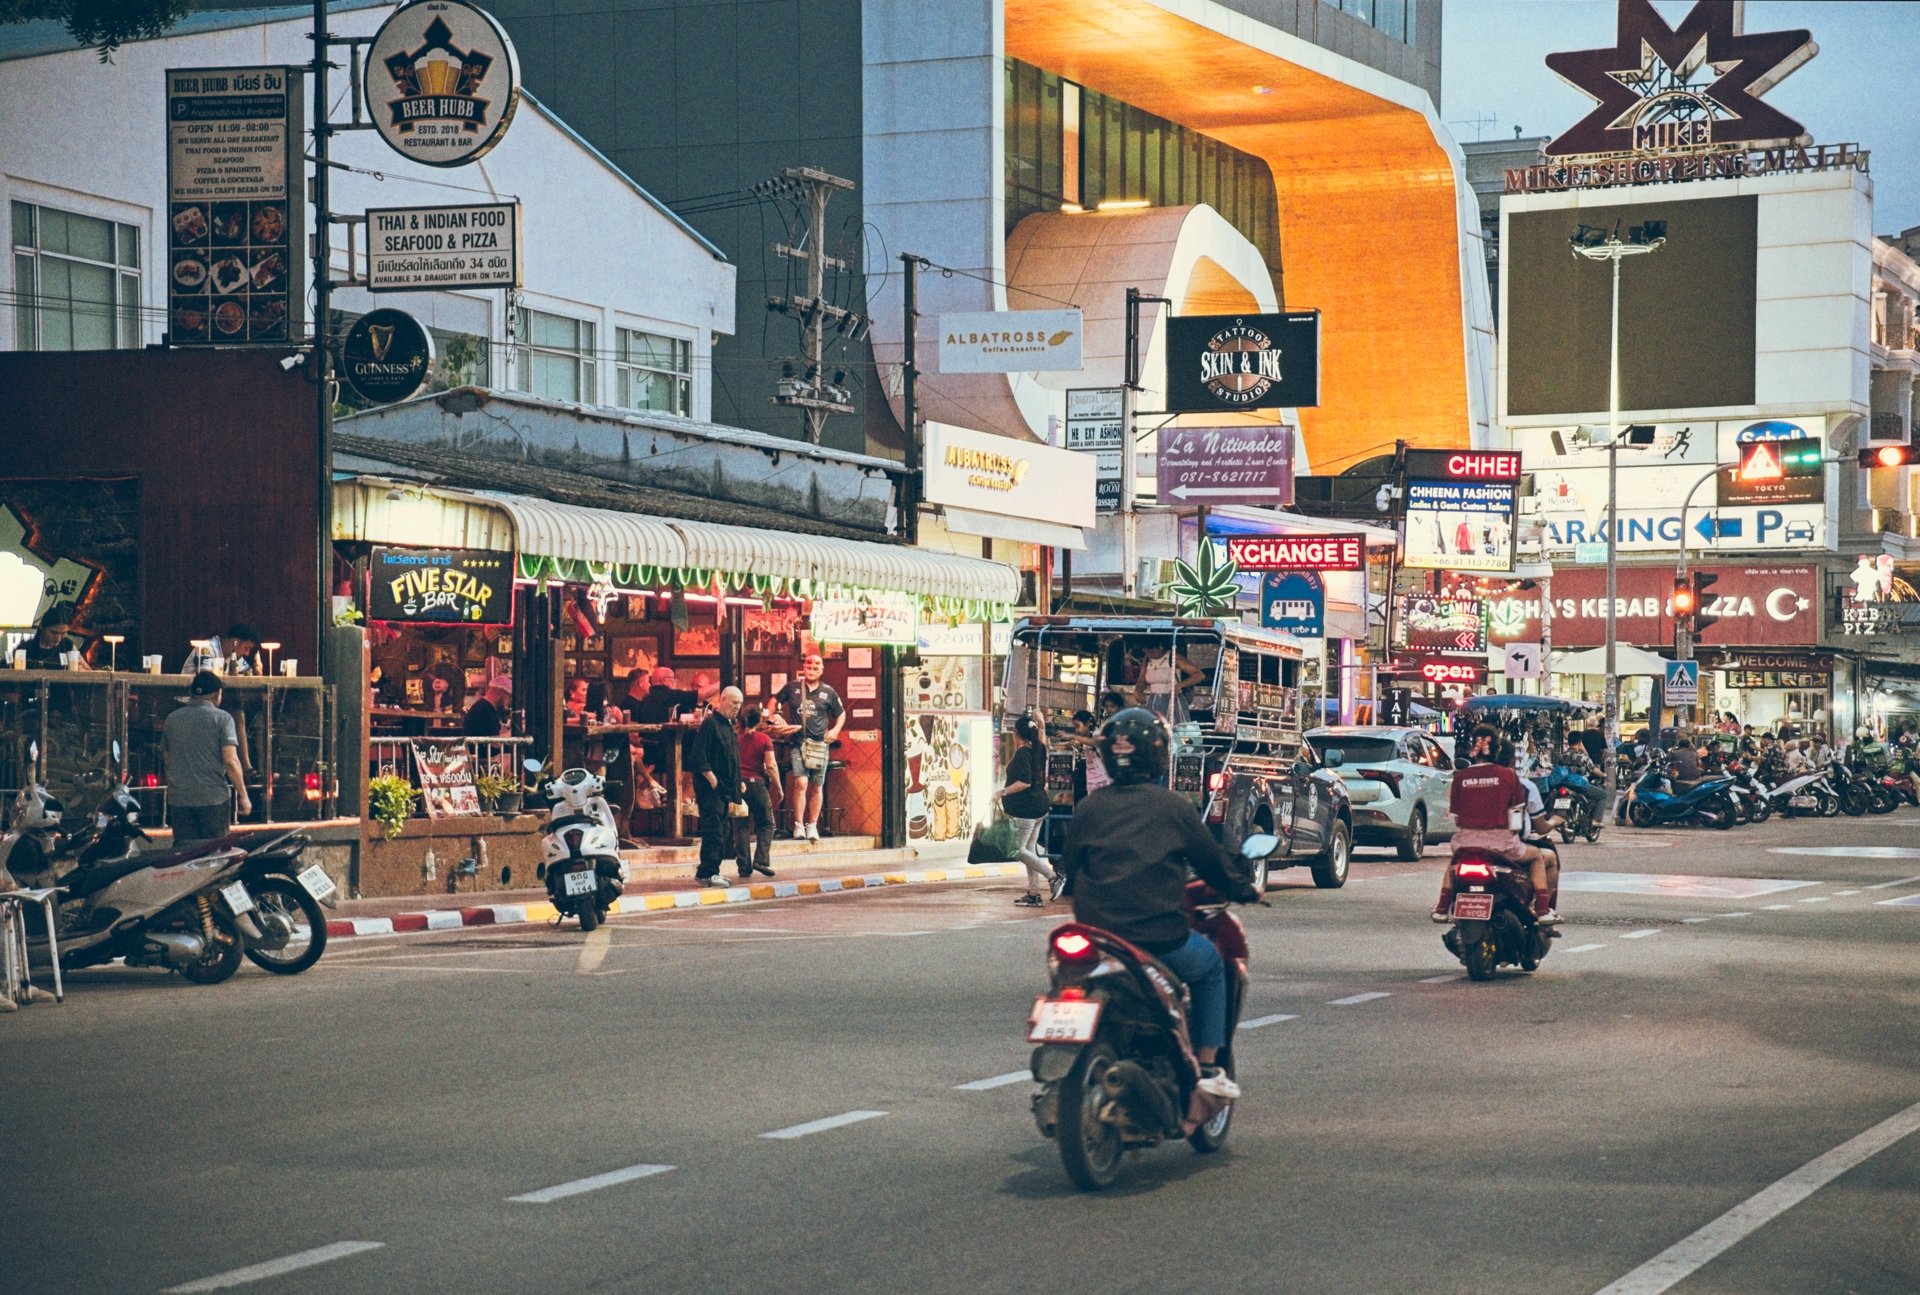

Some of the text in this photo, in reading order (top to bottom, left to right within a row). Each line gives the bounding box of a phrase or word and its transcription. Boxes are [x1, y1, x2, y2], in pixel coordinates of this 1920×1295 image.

[174, 78, 199, 93] BEER
[202, 77, 229, 94] HUBB
[402, 99, 475, 118] BEER HUBB
[187, 124, 214, 133] OPEN
[418, 125, 459, 134] ESTD. 2018
[1633, 119, 1711, 150] MIKE
[242, 135, 280, 143] BREAKFAST
[404, 138, 472, 147] RESTAURANT & BAR
[254, 145, 273, 153] FOOD
[213, 156, 245, 164] SEAFOOD
[1504, 143, 1859, 194] MIKE SHOPPING MALL
[193, 177, 219, 185] COFFEE
[186, 187, 205, 195] HAVE
[377, 210, 505, 231] THAI & INDIAN FOOD
[385, 232, 498, 252] SEAFOOD & PIZZA
[469, 257, 484, 269] 34
[487, 256, 507, 269] ชนิด
[374, 271, 511, 284] AVAILABLE 34 DRAUGHT BEER ON TAPS
[947, 331, 1045, 345] ALBATROSS
[1216, 327, 1263, 343] TATTOO
[355, 362, 409, 375] GUINNESS
[1201, 349, 1282, 381] SKIN & INK
[1216, 385, 1263, 402] STUDIO
[1166, 431, 1282, 455] La Nitivadee
[944, 445, 1015, 477] ALBATROSS
[1160, 456, 1199, 468] Dermatology
[1200, 458, 1213, 467] and
[1245, 456, 1265, 467] Laser
[1266, 456, 1288, 468] Center
[1180, 471, 1268, 483] 081-8621717
[1410, 486, 1512, 500] CHHEENA FASHION
[1754, 484, 1786, 493] TOKYO
[1096, 498, 1119, 508] assage
[1409, 499, 1511, 512] Ladies & Gents Custom Tailors
[1549, 510, 1784, 545] ARKING P
[1230, 543, 1360, 563] XCHANGE E
[390, 567, 493, 607] FIVE STAR
[421, 591, 460, 613] BAR
[1582, 597, 1659, 618] KEBAB
[868, 607, 908, 624] STAR
[1291, 626, 1310, 634] STOP
[1735, 655, 1808, 668] WELCOME
[1423, 664, 1475, 681] open
[1462, 778, 1478, 787] COLD
[1479, 777, 1499, 786] STONE
